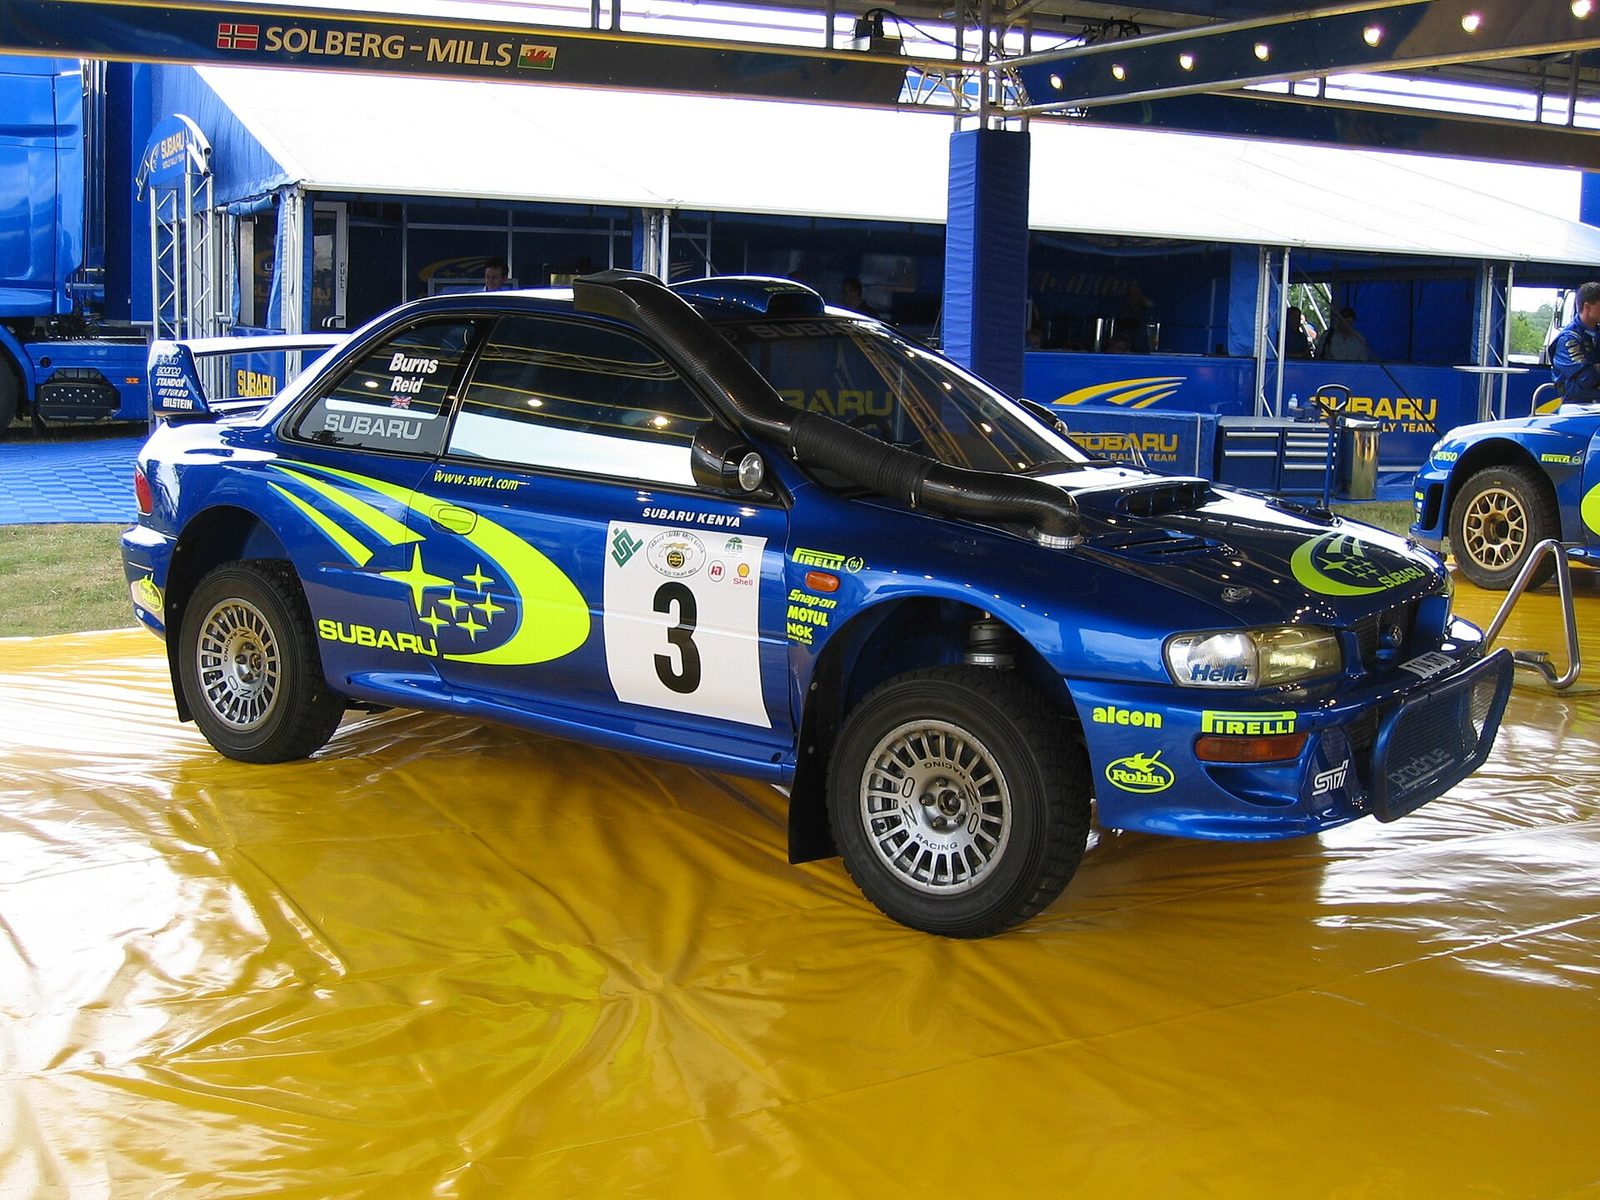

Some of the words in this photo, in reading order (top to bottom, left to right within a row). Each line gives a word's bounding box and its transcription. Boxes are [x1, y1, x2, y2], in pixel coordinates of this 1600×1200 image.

[388, 352, 439, 374] Burns
[390, 375, 424, 394] Reid
[162, 397, 193, 410] BILSTEIN
[324, 413, 422, 440] SUBARU
[1402, 423, 1435, 433] TEAM
[1148, 453, 1177, 462] TEAM
[433, 471, 518, 491] www.swrt.com
[642, 507, 694, 523] SUBARU
[696, 512, 741, 528] KENYA
[792, 547, 845, 571] PIRELLI
[733, 577, 753, 587] Shell
[1378, 566, 1426, 589] SUBARU
[788, 588, 837, 609] Snap-on
[787, 605, 828, 627] MOTUL
[318, 618, 439, 657] SUBARU
[653, 581, 701, 695] 3
[787, 622, 814, 639] NGK
[1191, 663, 1248, 682] Hella
[1092, 705, 1162, 728] alcon
[1201, 710, 1297, 735] PIRELLI
[1112, 769, 1165, 786] Robin
[915, 833, 959, 851] RACING
